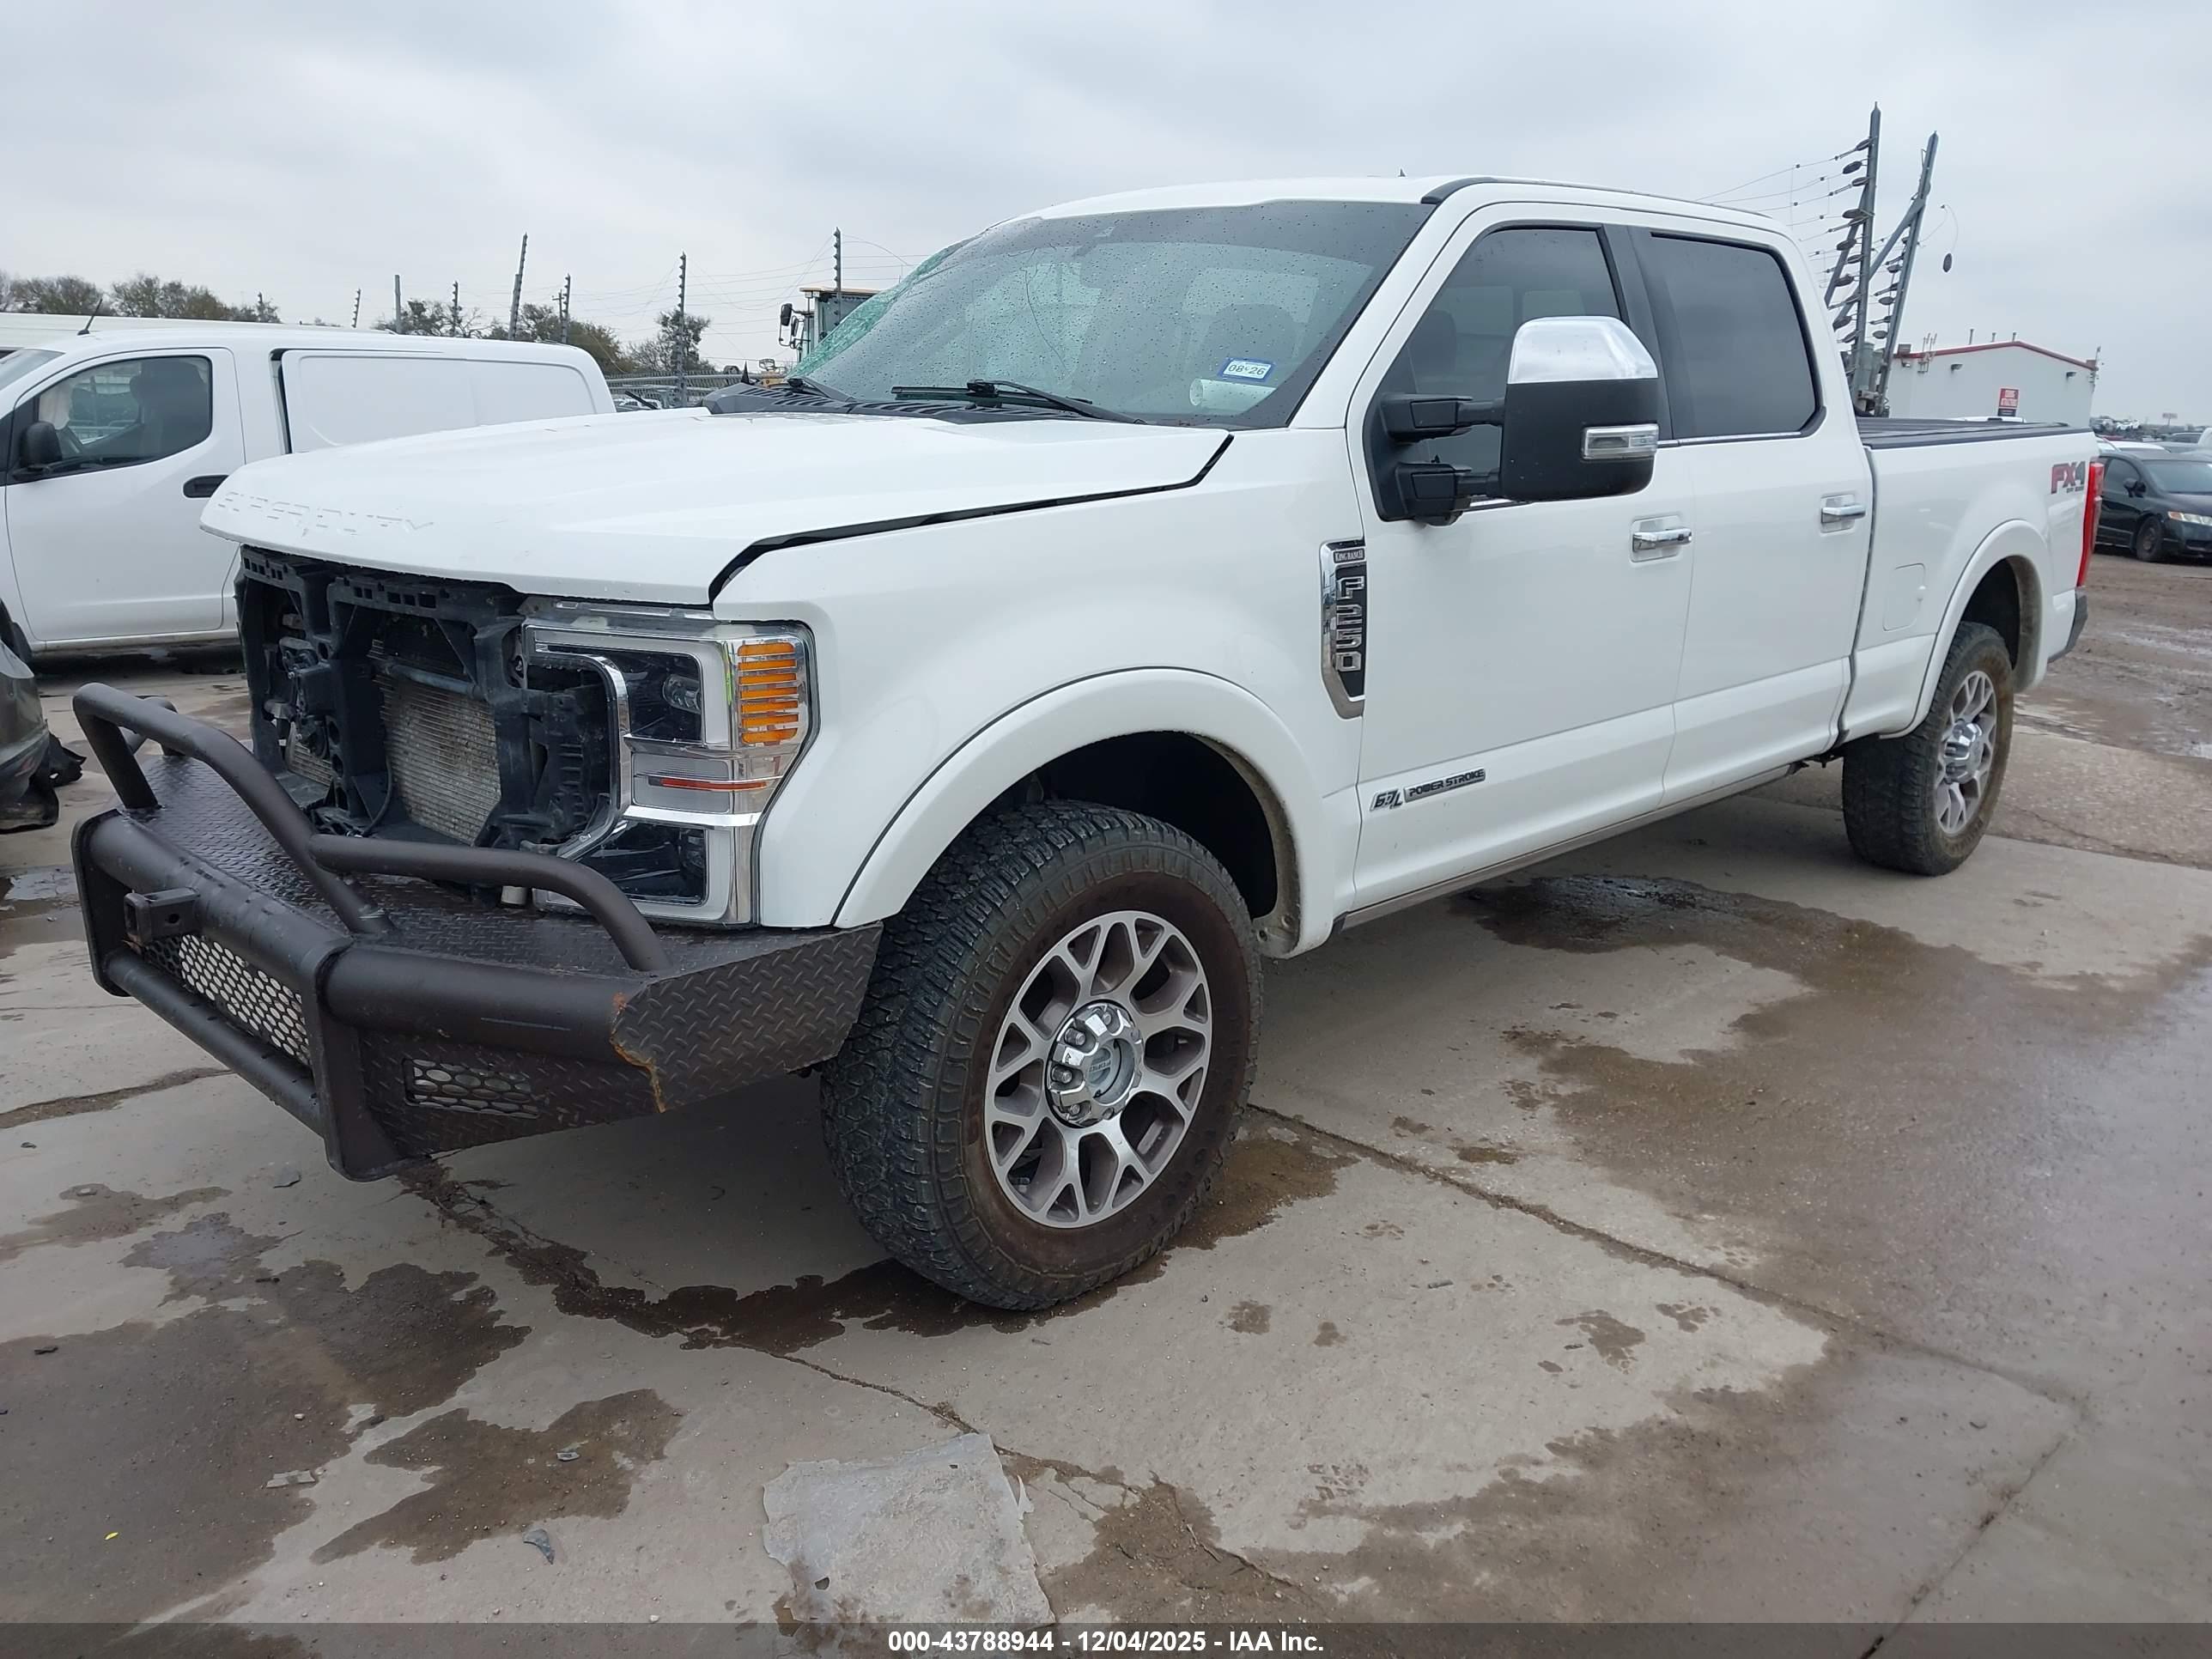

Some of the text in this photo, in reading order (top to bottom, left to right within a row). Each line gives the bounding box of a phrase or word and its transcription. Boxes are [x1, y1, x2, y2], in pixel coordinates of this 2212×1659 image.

[1228, 364, 1266, 375] 08 26
[2051, 461, 2086, 494] FX4
[1408, 780, 1444, 798] POWER
[1445, 768, 1485, 787] STROKE
